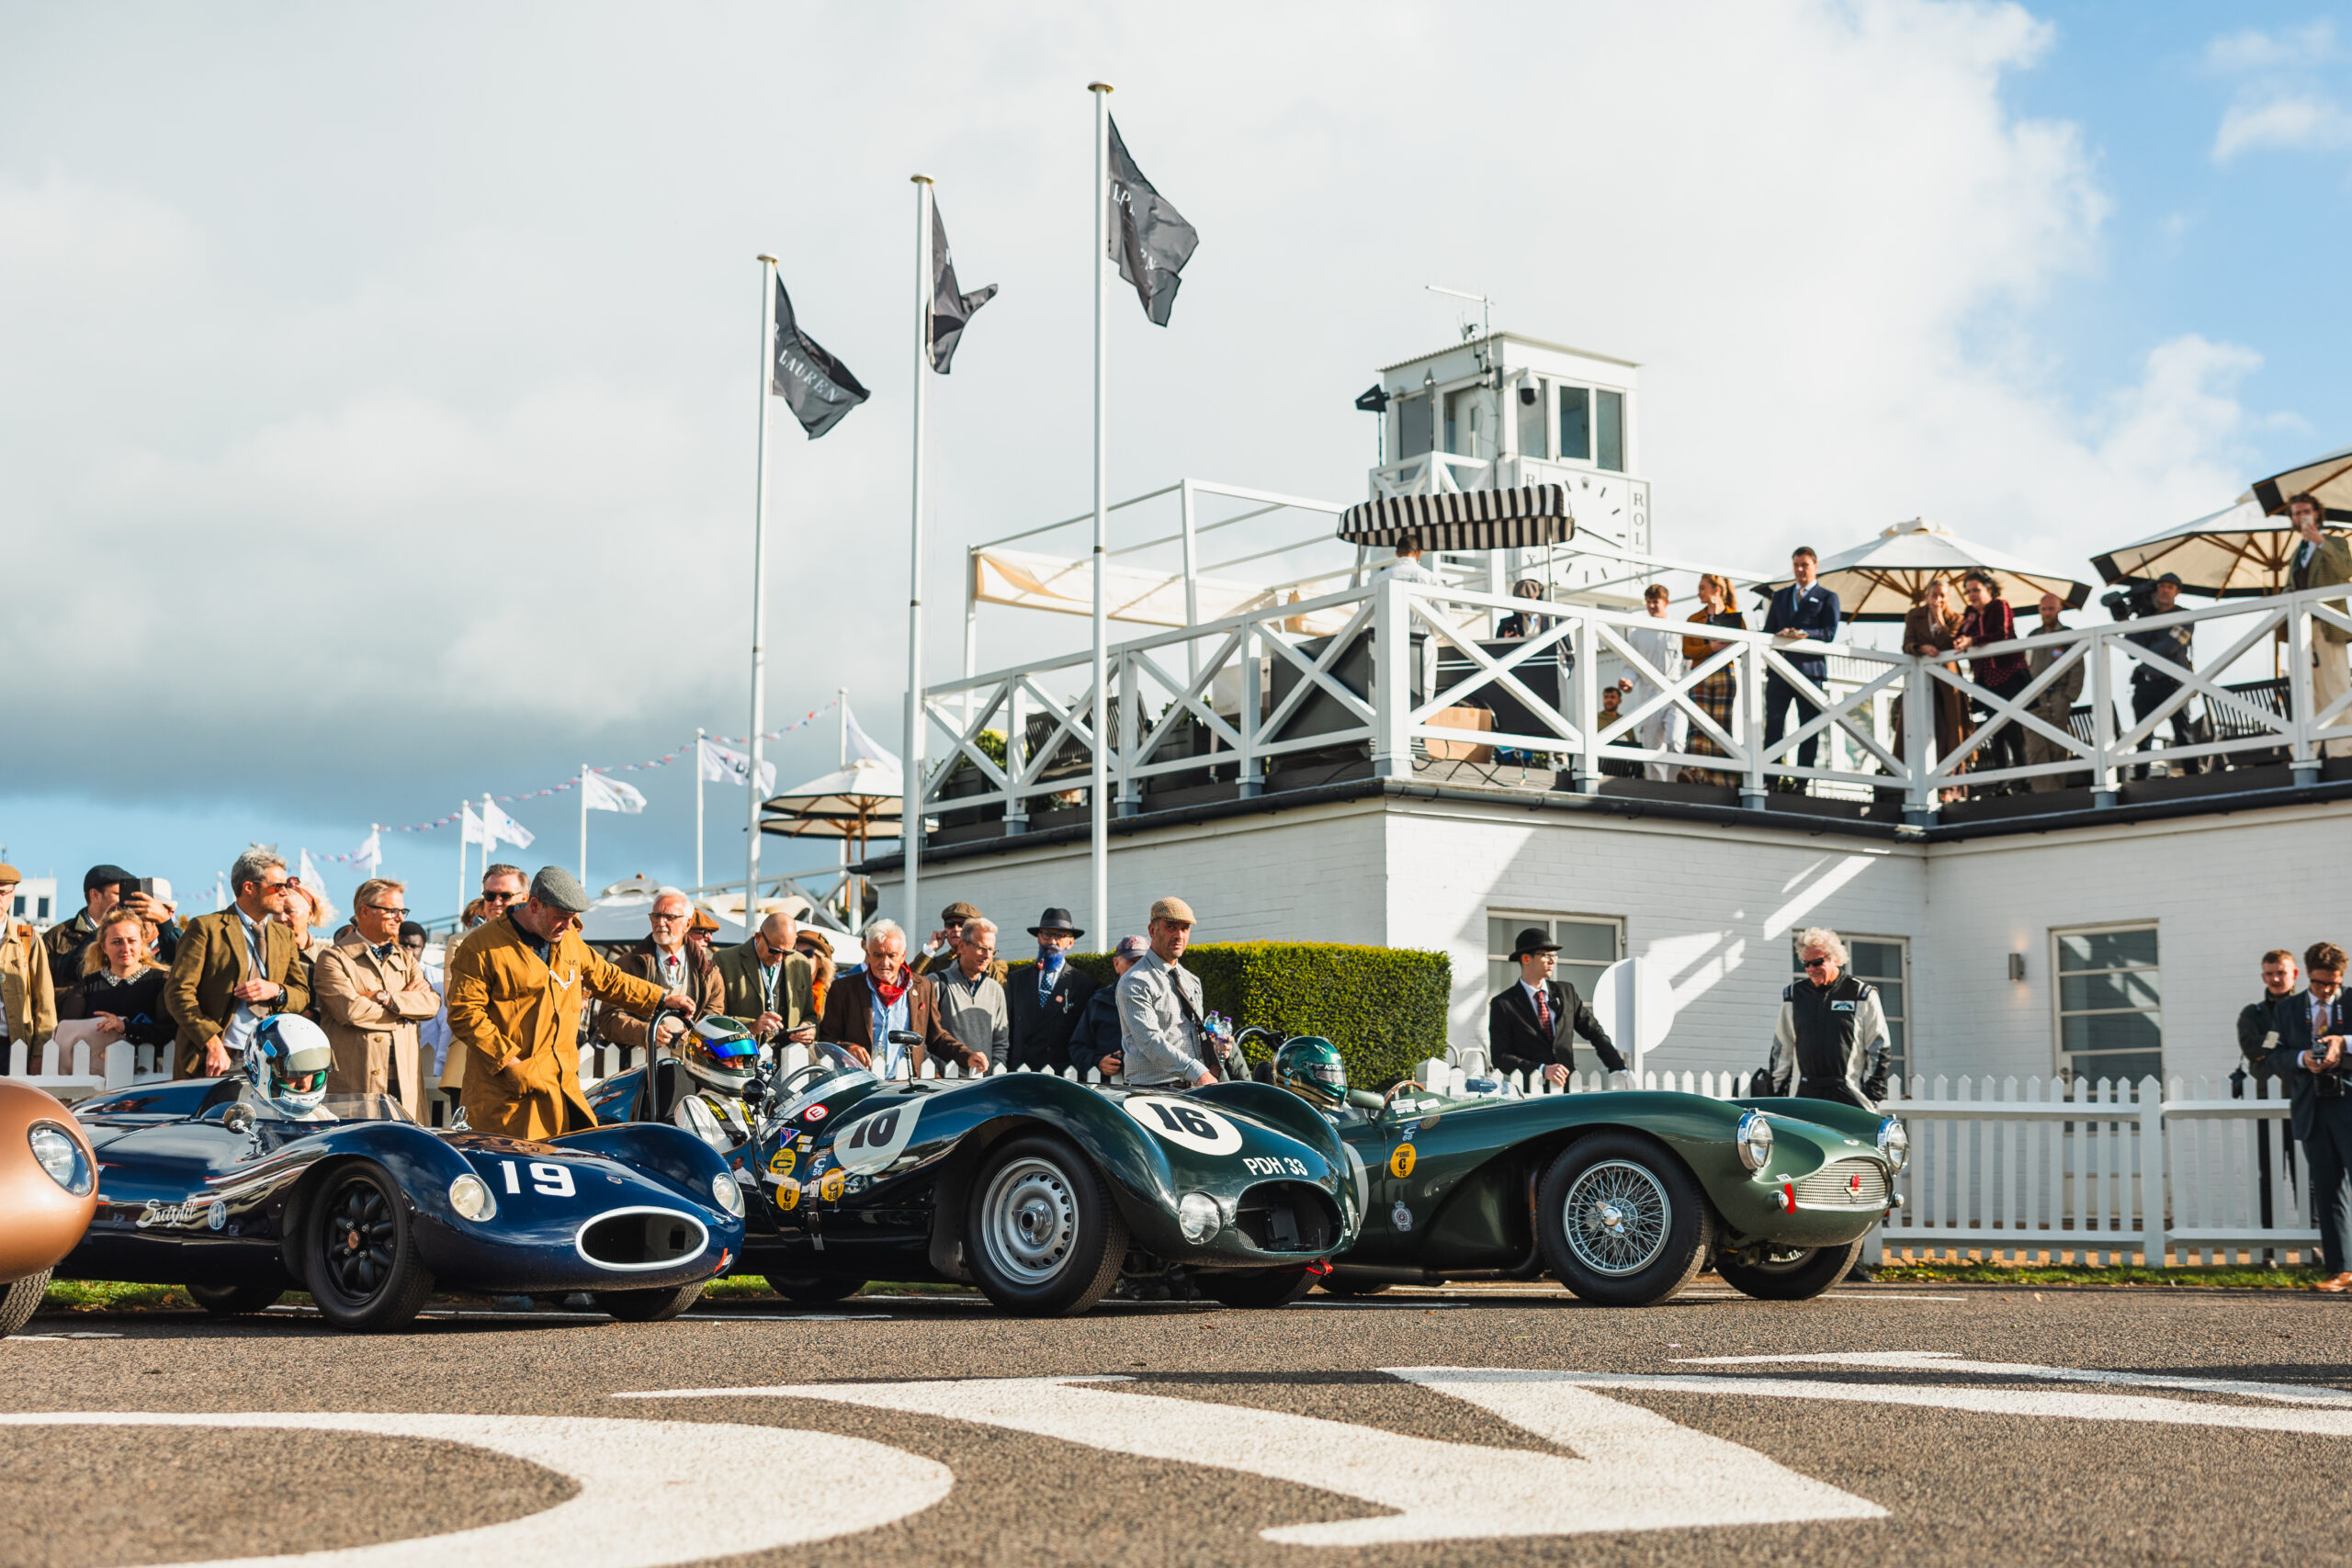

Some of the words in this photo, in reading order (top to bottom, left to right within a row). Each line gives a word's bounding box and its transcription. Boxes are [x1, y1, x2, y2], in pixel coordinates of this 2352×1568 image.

[779, 349, 840, 402] LAUREN
[1633, 492, 1645, 585] ROLX
[1146, 1102, 1219, 1140] 16
[814, 1158, 827, 1168] C
[1242, 1157, 1285, 1177] PDH
[1284, 1157, 1308, 1177] 33
[1398, 1158, 1407, 1169] C
[501, 1160, 577, 1198] 19
[784, 1190, 792, 1201] C
